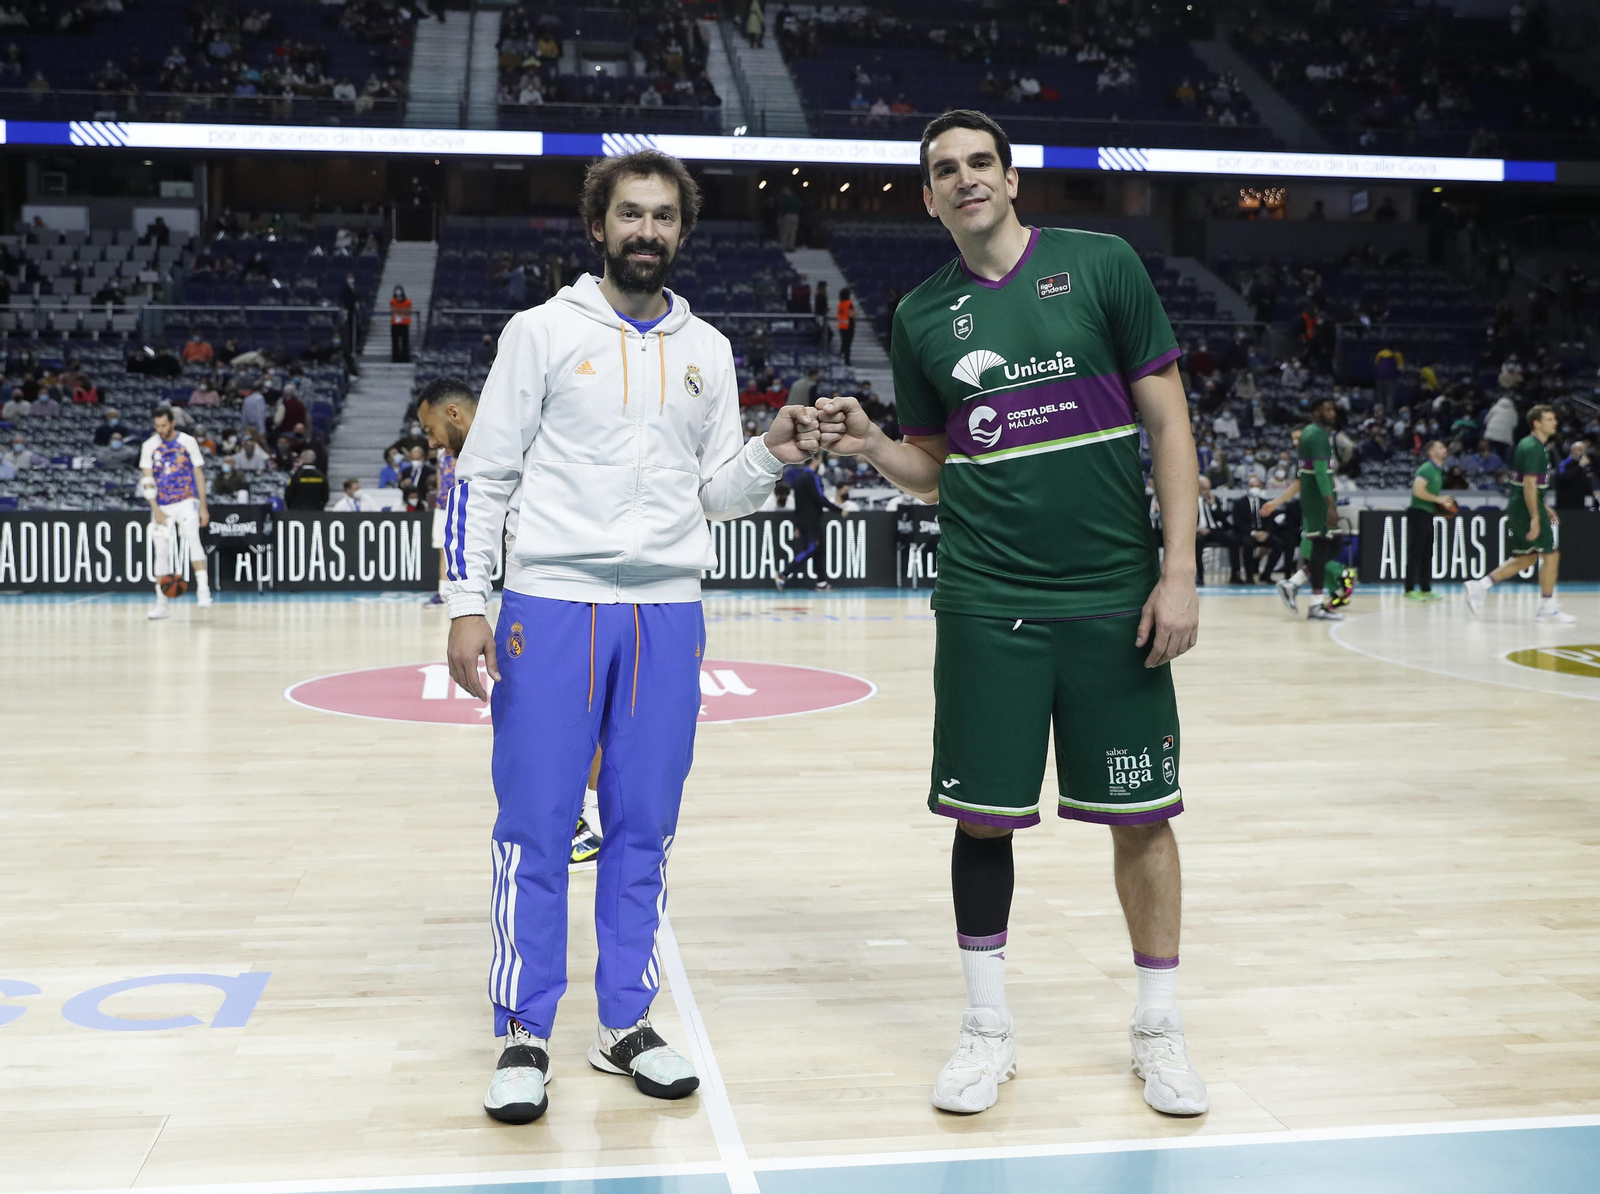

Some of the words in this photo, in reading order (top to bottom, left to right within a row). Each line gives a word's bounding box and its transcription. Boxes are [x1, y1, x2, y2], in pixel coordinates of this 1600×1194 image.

[209, 131, 237, 147] por
[244, 132, 263, 143] un
[268, 133, 328, 144] acceso
[333, 131, 354, 145] de
[360, 132, 374, 145] la
[379, 132, 416, 146] calle
[421, 133, 465, 150] Goya
[731, 142, 758, 158] por
[764, 144, 782, 155] un
[789, 145, 843, 156] acceso
[848, 143, 868, 157] de
[873, 143, 886, 157] la
[1216, 156, 1242, 172] por
[1247, 158, 1264, 168] un
[1269, 159, 1319, 170] acceso
[1324, 157, 1342, 171] de
[1347, 158, 1358, 171] la
[1363, 158, 1395, 172] calle
[1399, 158, 1438, 175] Goya
[1004, 351, 1075, 380] Unicaja
[1007, 408, 1039, 420] COSTA
[1039, 404, 1058, 415] DEL
[1059, 401, 1078, 411] SOL
[1008, 416, 1049, 430] MÁLAGA
[209, 521, 257, 535] SPALDING
[701, 519, 867, 580] DIDAS.OM
[1106, 747, 1128, 756] sabor
[1106, 756, 1113, 764] a
[1114, 747, 1153, 770] má
[1108, 766, 1153, 789] laga
